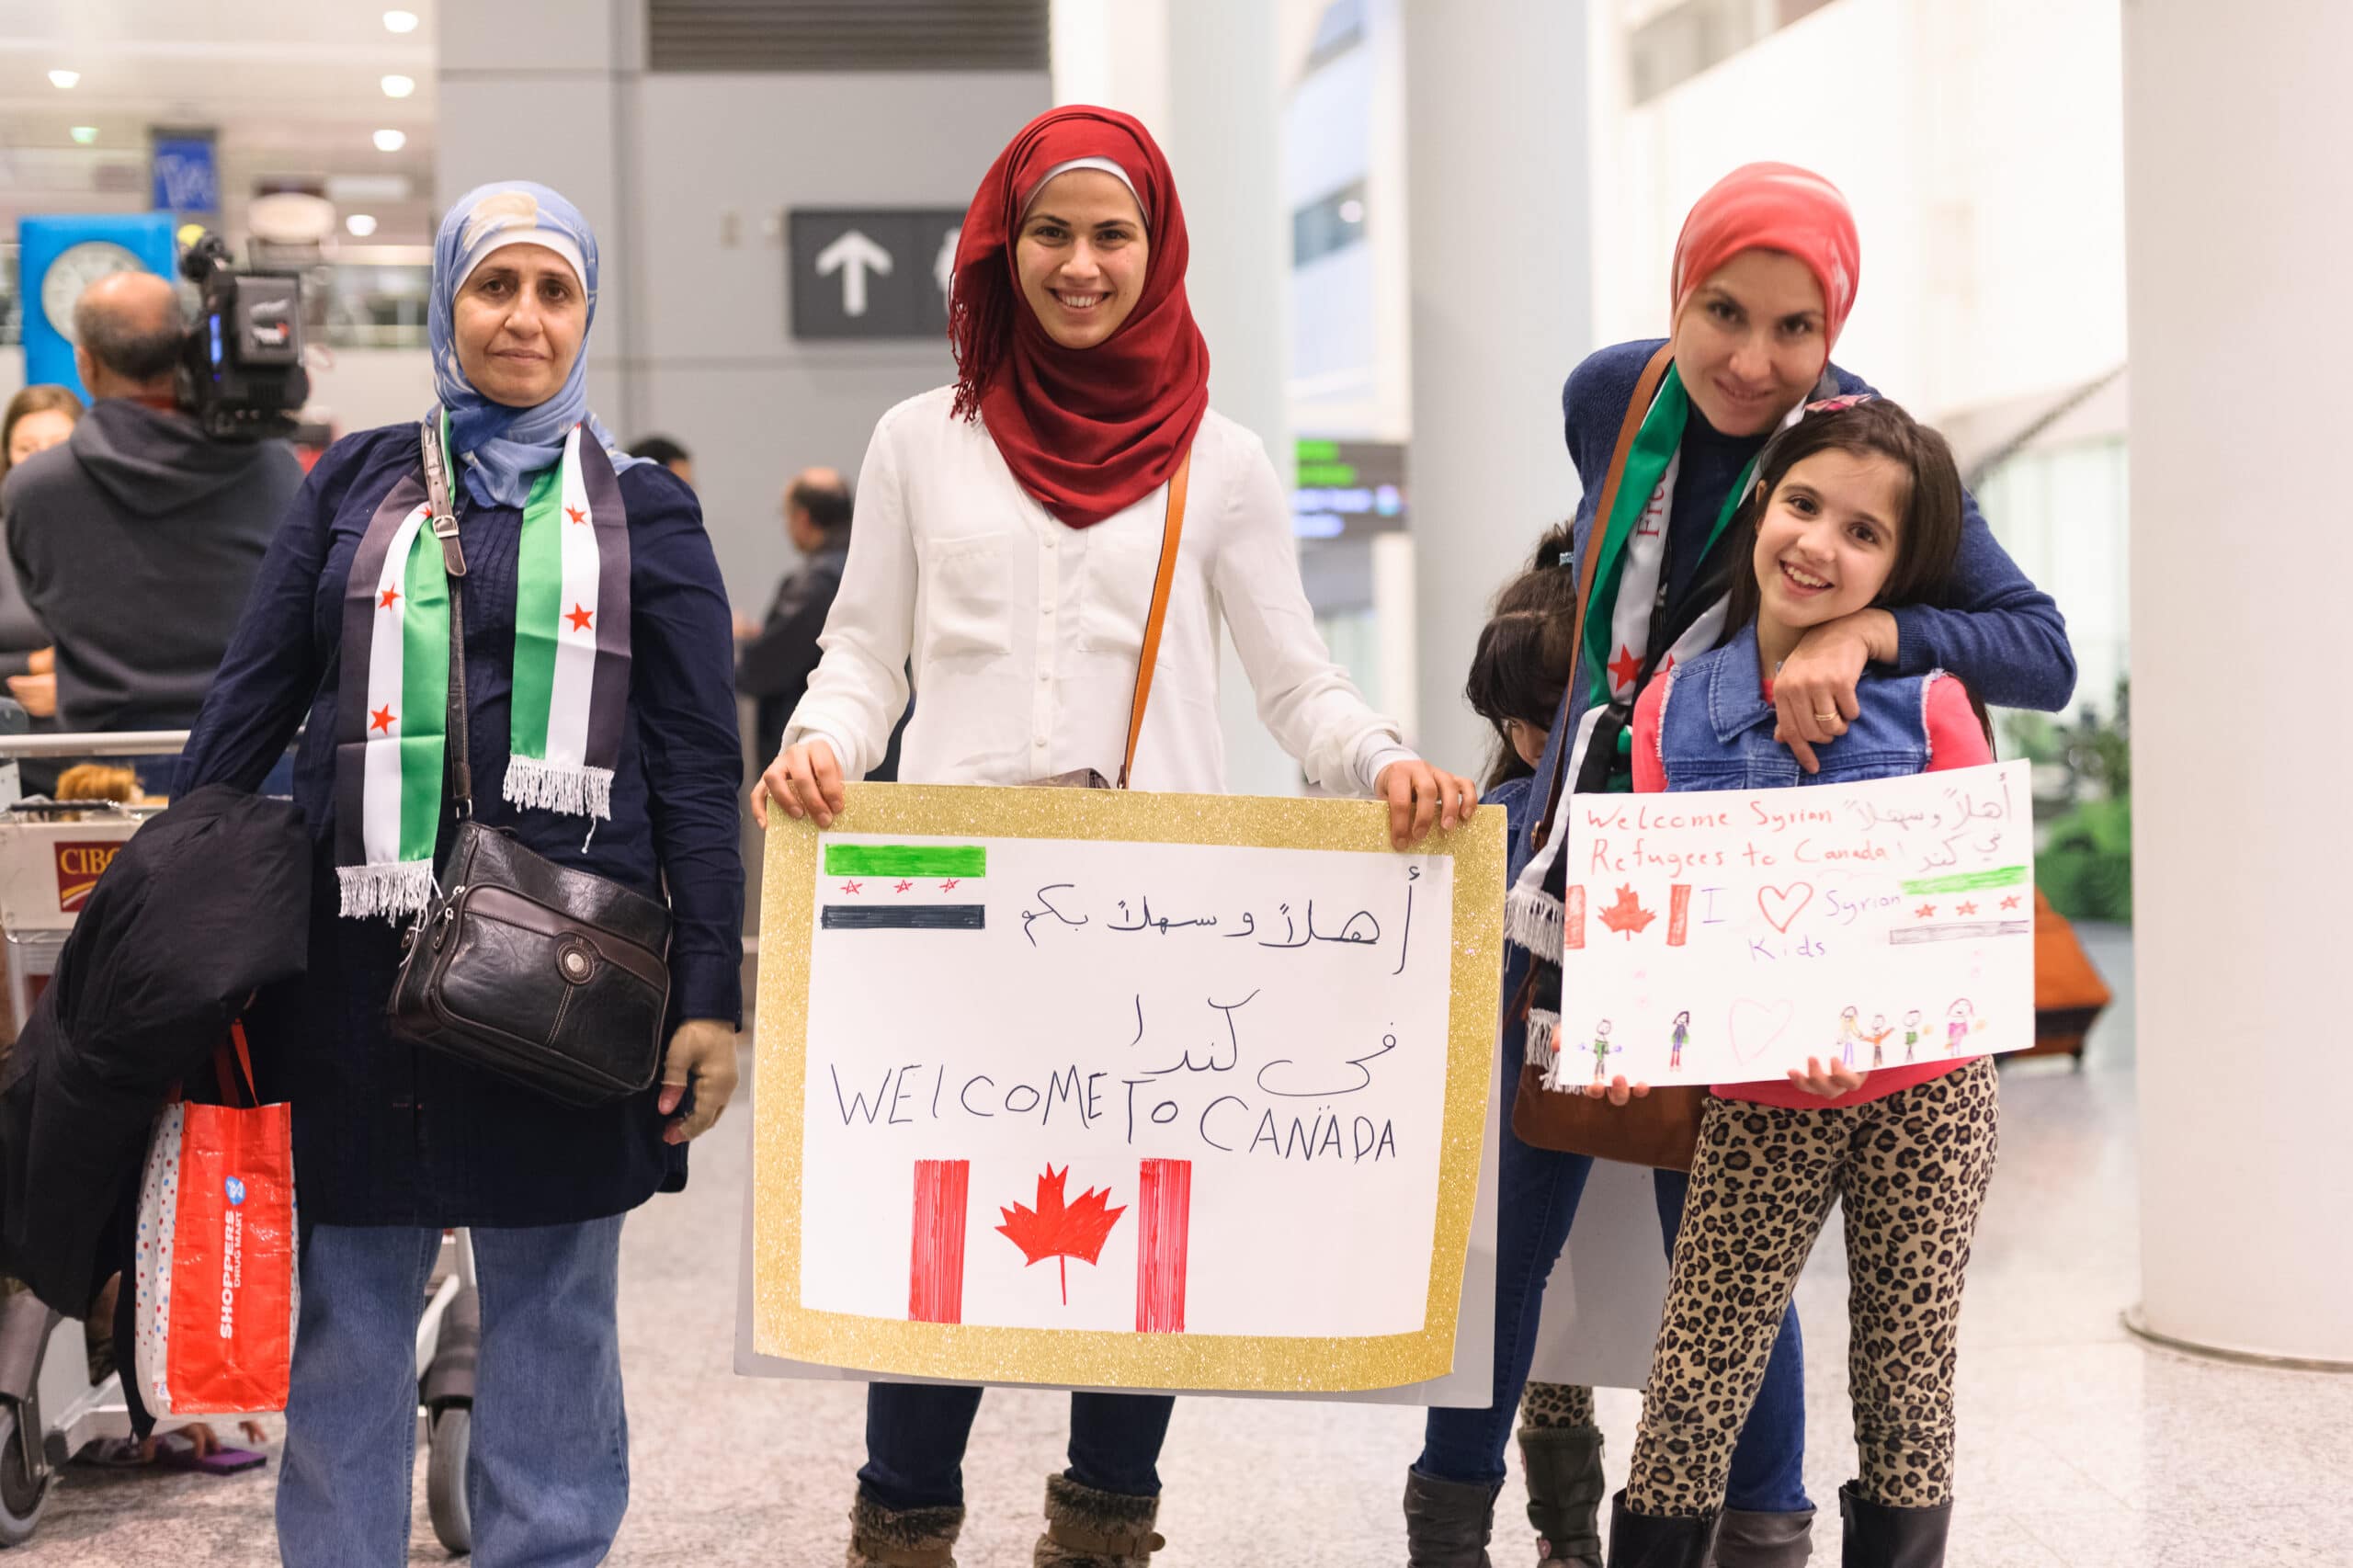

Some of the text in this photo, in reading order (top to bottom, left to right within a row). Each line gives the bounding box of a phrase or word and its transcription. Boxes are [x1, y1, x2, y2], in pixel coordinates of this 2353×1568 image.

[1587, 801, 1833, 833] Welcome Syrian
[1591, 837, 1889, 879] Refugees to Canada
[1021, 884, 1089, 948] بكم
[1700, 887, 1902, 926] I Syrian
[1747, 934, 1826, 960] Kids
[1199, 1095, 1396, 1164] CANADA
[220, 1210, 235, 1340] SHOPPERS
[233, 1210, 244, 1289] DRUG MART
